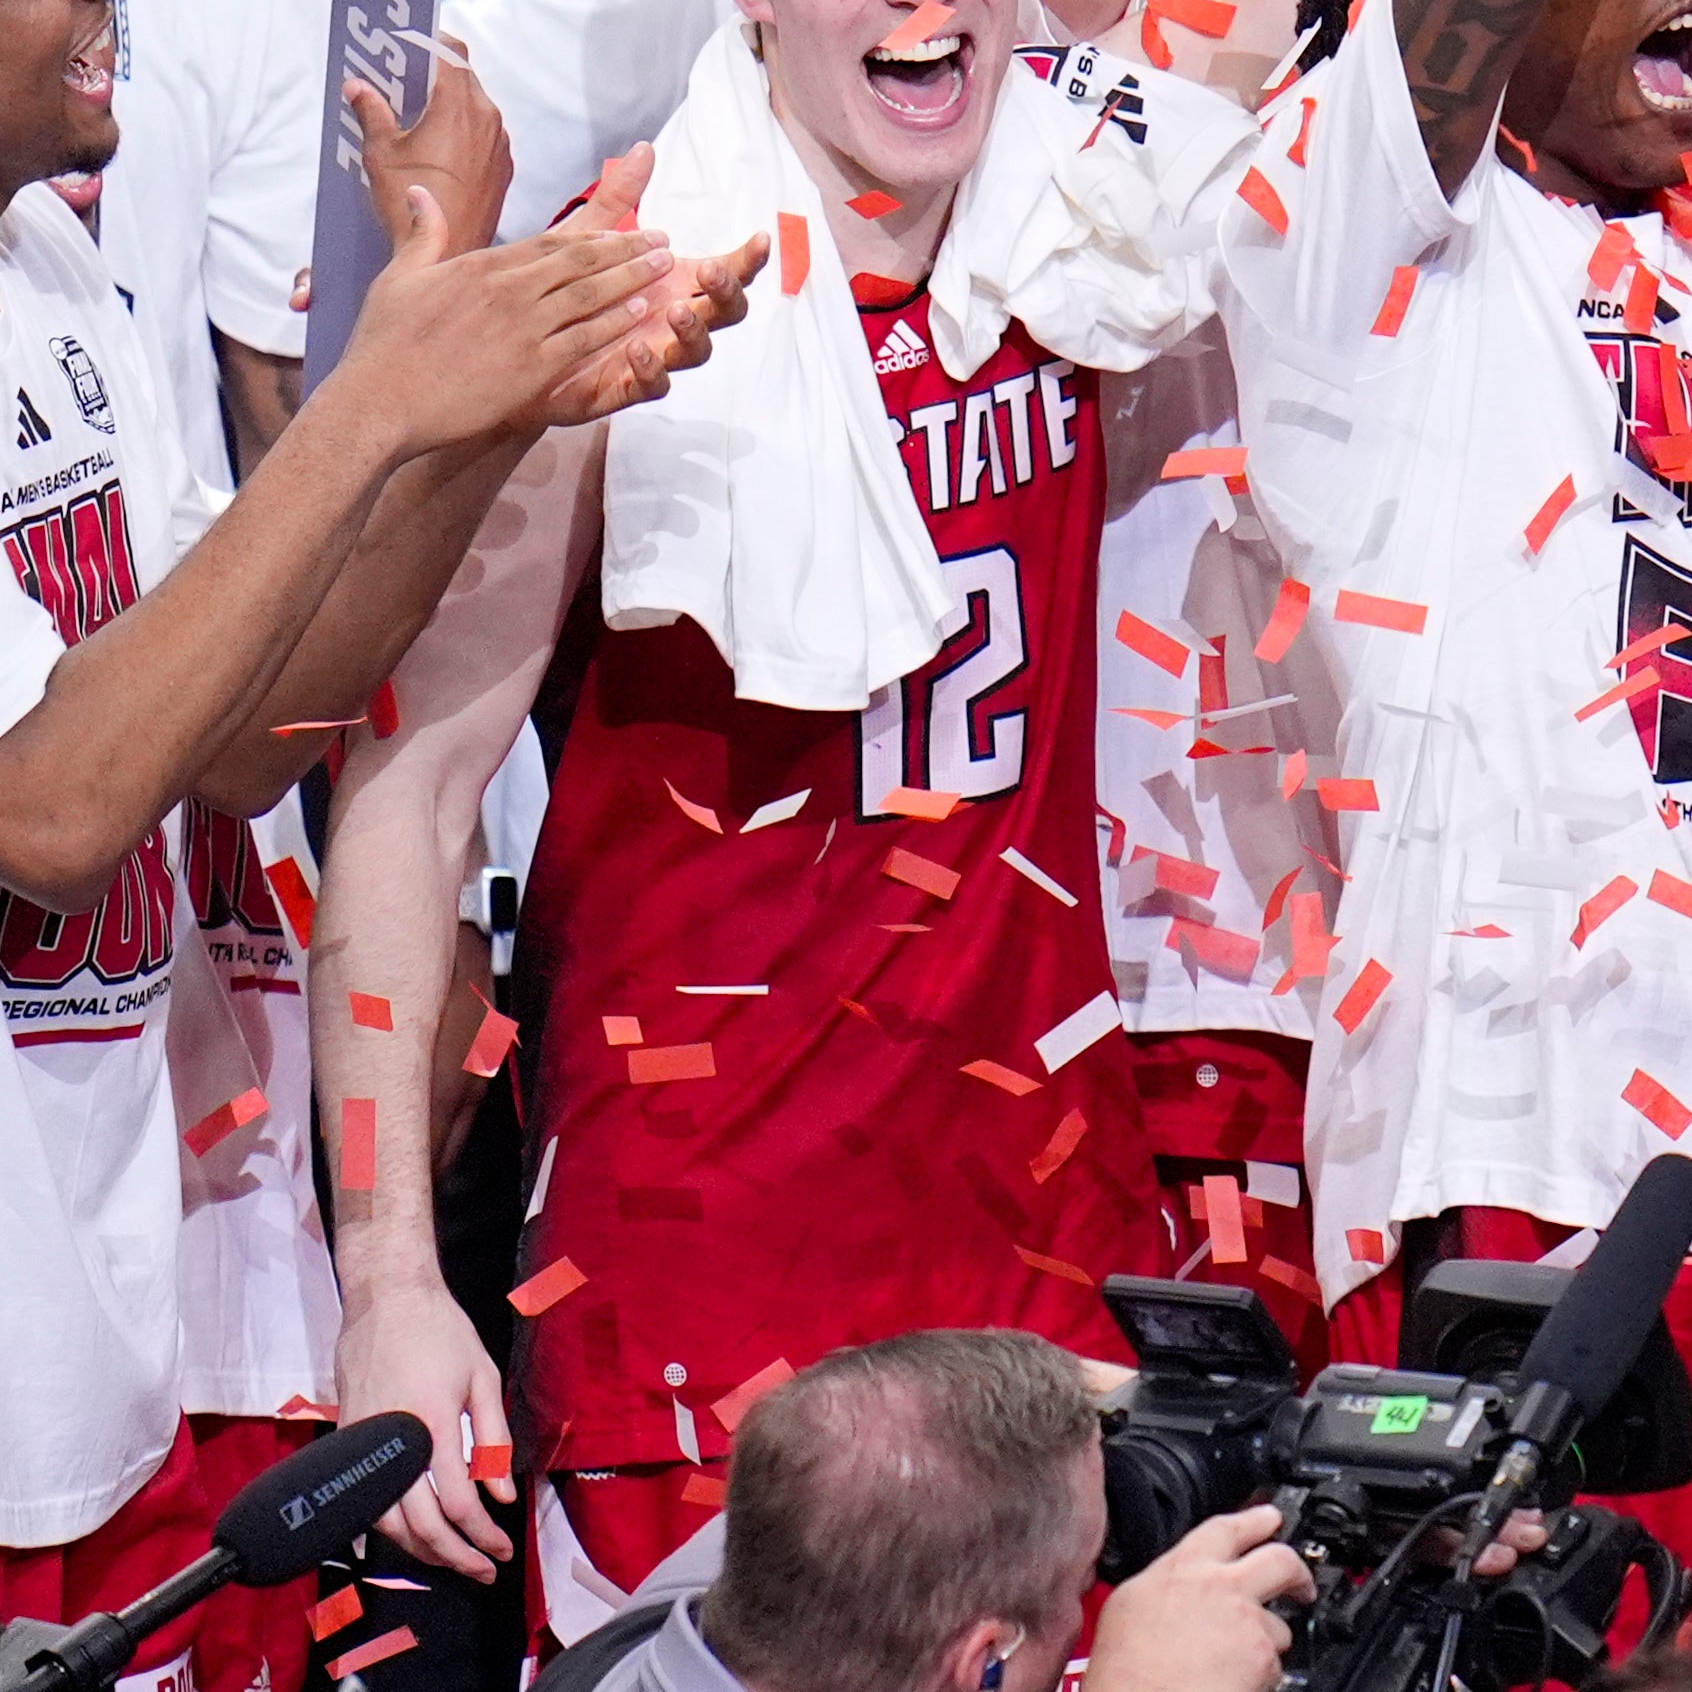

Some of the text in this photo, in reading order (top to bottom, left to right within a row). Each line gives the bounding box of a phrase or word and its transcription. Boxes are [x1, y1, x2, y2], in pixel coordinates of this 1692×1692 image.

[336, 5, 408, 190] STE
[1577, 298, 1627, 320] NCA
[874, 346, 931, 375] adidas
[888, 359, 1078, 515] TATE
[45, 447, 115, 494] BASKETBALL
[311, 1435, 407, 1508] SENNHEISER
